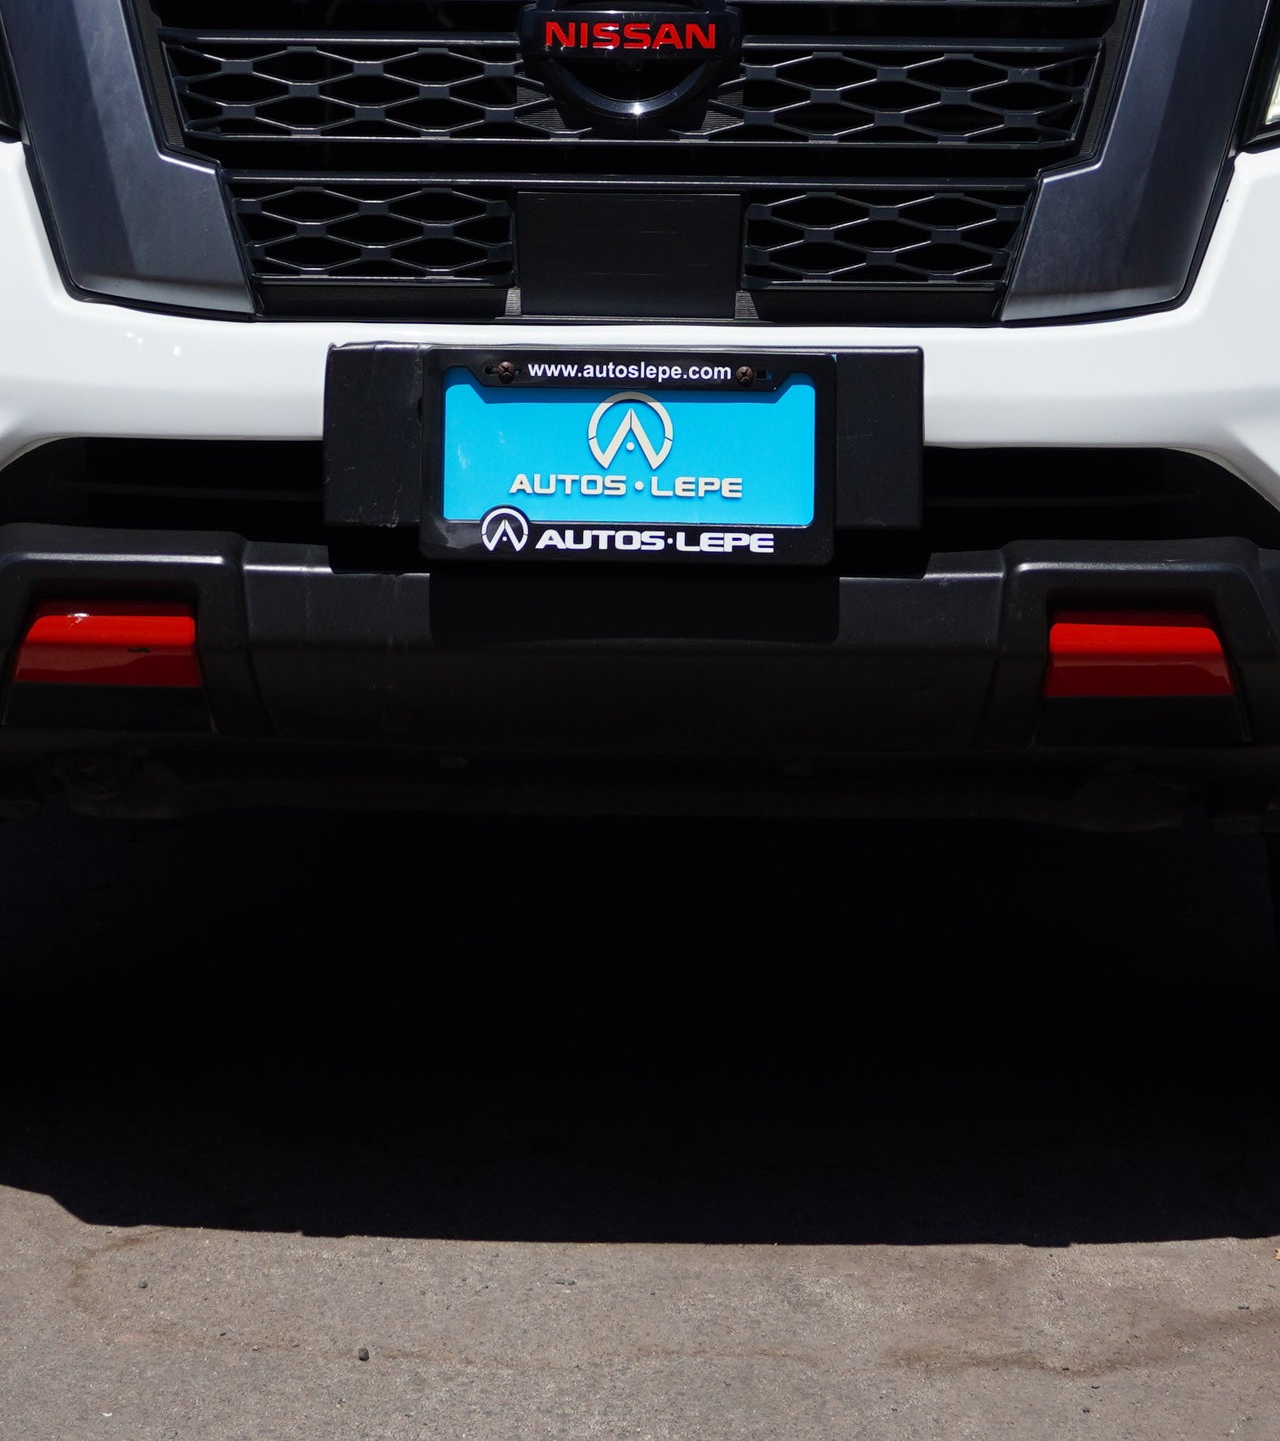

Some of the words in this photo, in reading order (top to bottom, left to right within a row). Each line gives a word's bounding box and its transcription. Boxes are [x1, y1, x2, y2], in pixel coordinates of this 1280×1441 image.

[545, 21, 716, 50] NISSAN
[528, 361, 732, 384] www.autoslepe.com
[509, 473, 627, 497] AUTOS
[650, 475, 743, 500] LEPE
